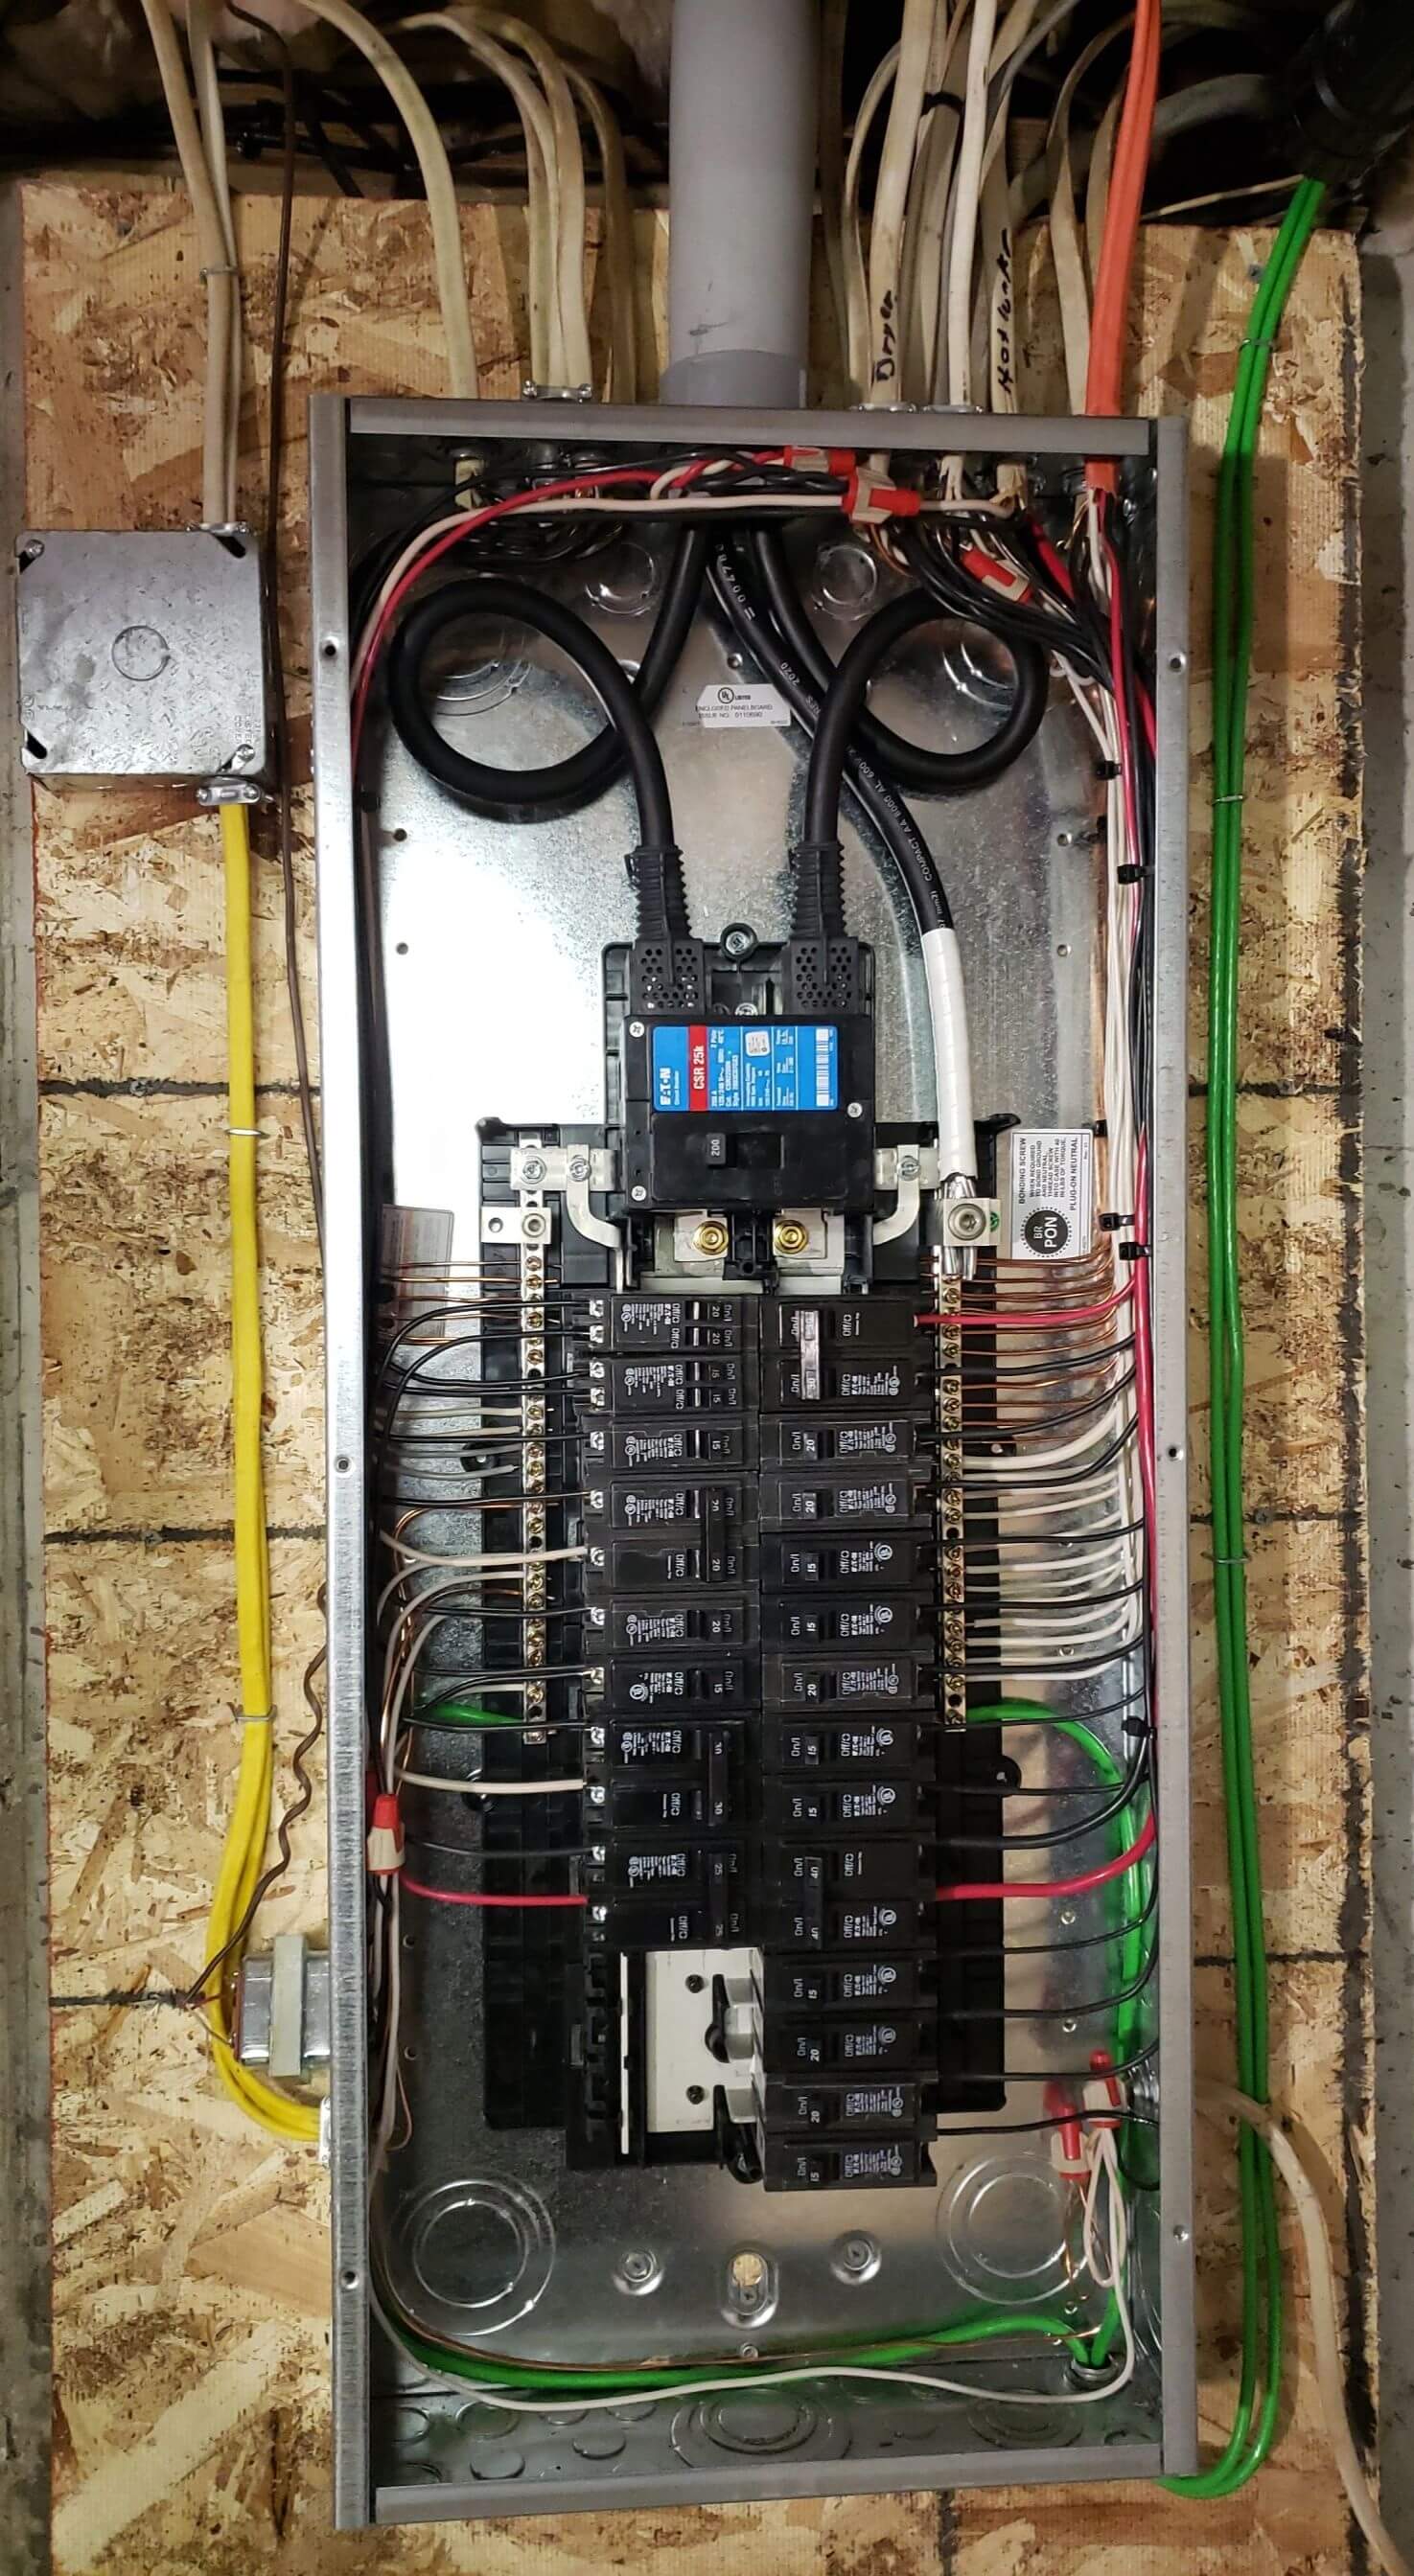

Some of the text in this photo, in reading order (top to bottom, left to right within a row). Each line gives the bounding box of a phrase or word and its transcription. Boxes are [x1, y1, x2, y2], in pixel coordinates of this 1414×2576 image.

[779, 661, 800, 687] 2020
[874, 779, 887, 794] AL
[908, 837, 934, 883] COMPACT
[692, 1045, 706, 1090] CSR 25k
[710, 1138, 720, 1157] 200
[1069, 1137, 1078, 1211] PLUG-ON NEUTRAL
[1033, 1226, 1044, 1239] BR
[1044, 1216, 1057, 1248] PON
[711, 1305, 721, 1318] 20
[712, 1332, 721, 1345] 20
[712, 1393, 721, 1403] 15
[712, 1440, 721, 1450] 15
[806, 1439, 815, 1452] 20
[805, 1501, 815, 1513] 20
[712, 1558, 721, 1572] 20
[807, 1563, 817, 1573] 15
[712, 1620, 721, 1633] 20
[806, 1622, 816, 1632] 15
[714, 1684, 723, 1693] 15
[807, 1684, 817, 1696] 20
[807, 1745, 817, 1756] 15
[714, 1802, 723, 1815] 30
[808, 1807, 818, 1817] 15
[714, 1863, 723, 1875] 25
[715, 1923, 724, 1937] 25
[808, 1990, 818, 1999] 15
[810, 2049, 820, 2061] 20
[811, 2110, 820, 2124] 20
[810, 2173, 820, 2182] 15
